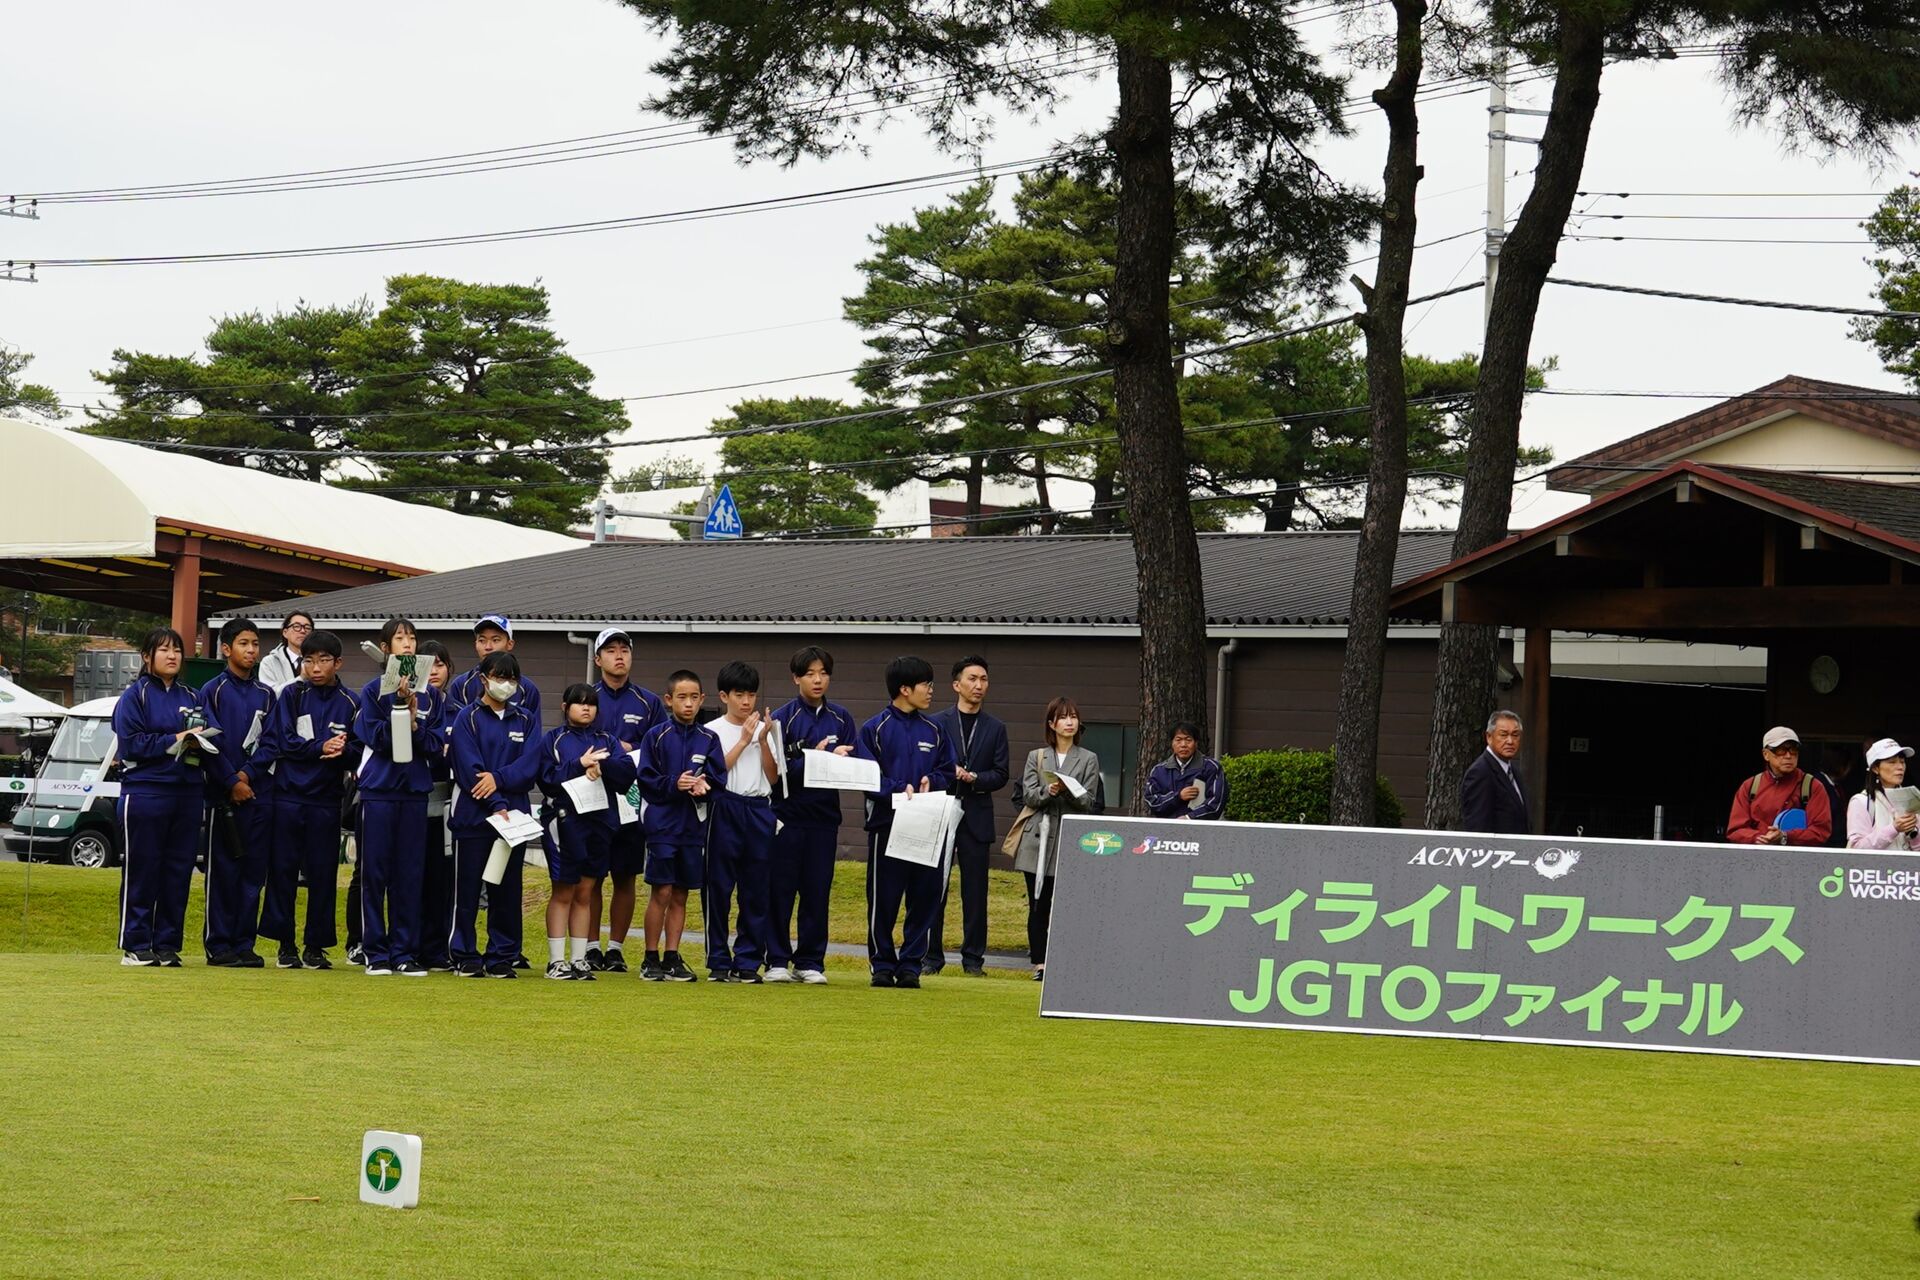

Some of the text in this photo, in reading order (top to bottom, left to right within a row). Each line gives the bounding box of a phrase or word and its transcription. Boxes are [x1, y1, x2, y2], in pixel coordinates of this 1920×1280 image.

[1153, 840, 1200, 852] J-TOUR
[1407, 846, 1530, 869] ACNツアー
[1849, 868, 1920, 886] DELiGH
[1183, 872, 1806, 966] ディライトワークス
[1229, 957, 1744, 1037] JGTOファイナル
